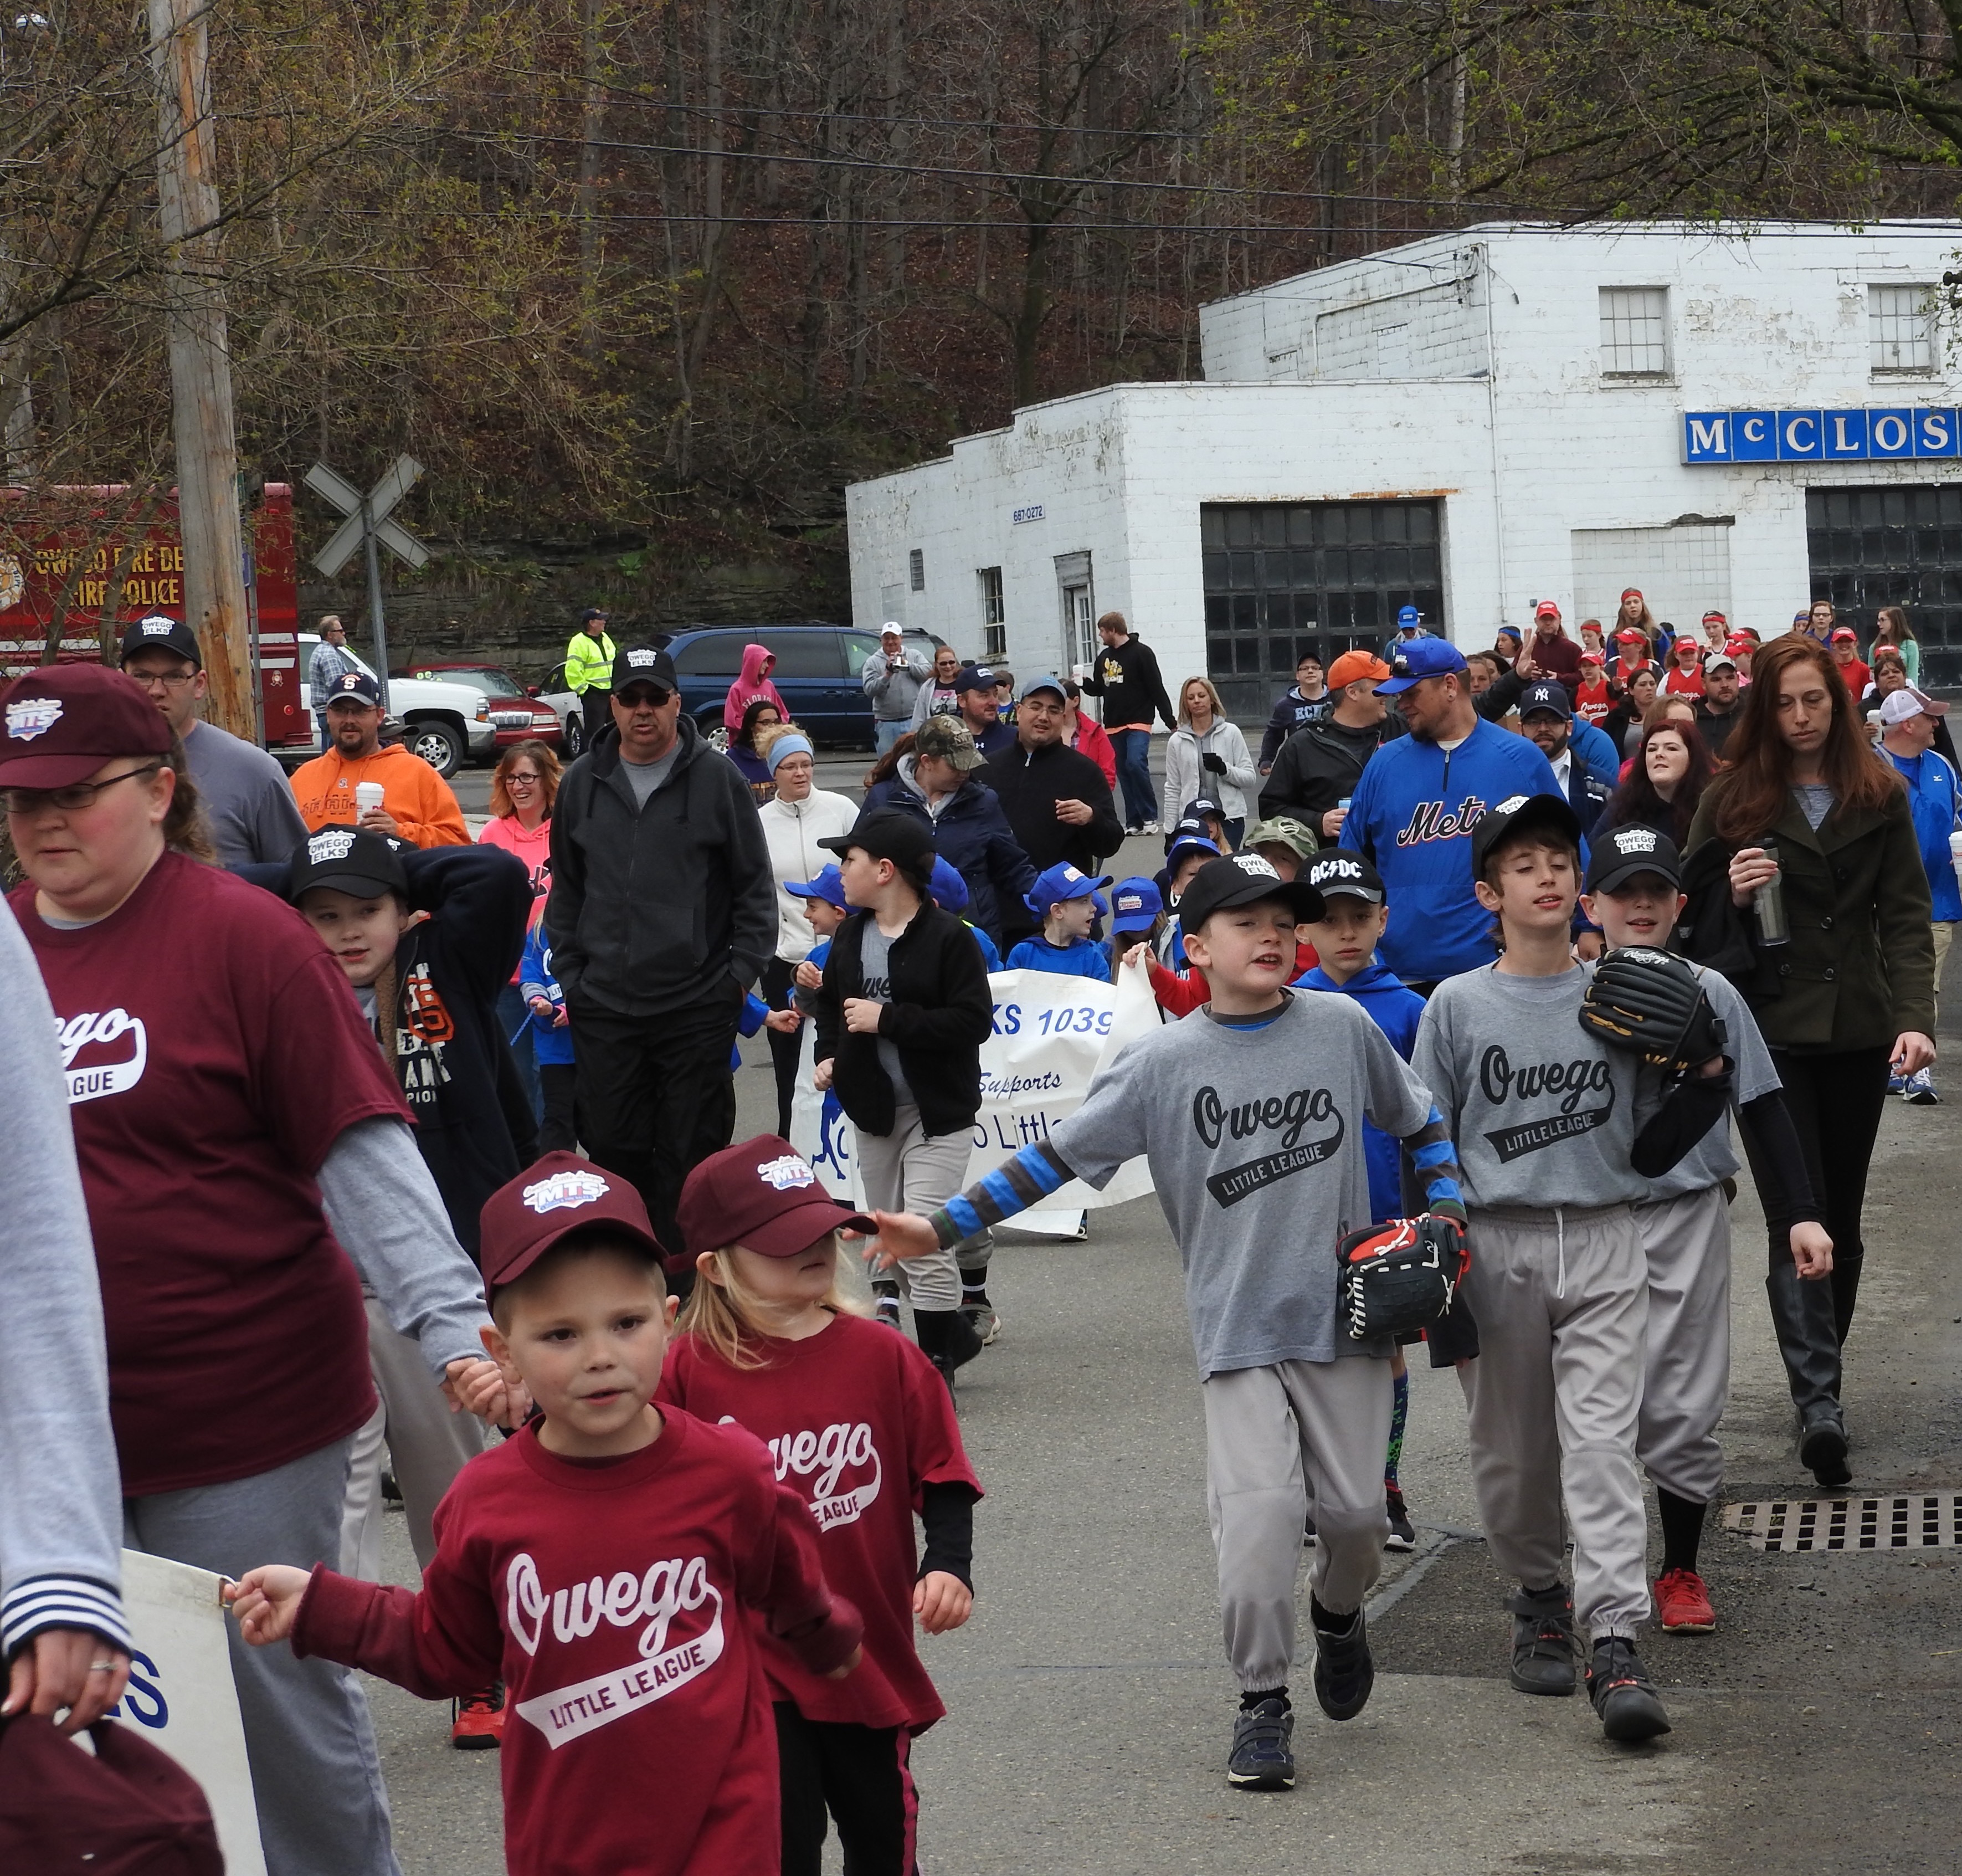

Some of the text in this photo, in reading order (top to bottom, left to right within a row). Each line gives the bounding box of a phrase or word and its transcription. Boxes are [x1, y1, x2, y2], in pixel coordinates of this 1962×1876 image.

[36, 548, 107, 575] OWO
[114, 547, 155, 572] FRE
[121, 579, 179, 605] OLICE
[1580, 702, 1607, 712] Owego
[311, 838, 350, 854] OWEGO
[1618, 836, 1654, 846] OWEGO
[1623, 843, 1652, 852] ELKS
[314, 848, 346, 862] ELKS
[1038, 1007, 1113, 1036] 1039
[979, 1071, 1062, 1099] Supports
[1480, 1044, 1610, 1114] Owego
[1193, 1086, 1332, 1150] Owego
[1504, 1126, 1549, 1152] LITTLE
[772, 1164, 813, 1184] MTS
[1221, 1144, 1324, 1196] LITTLE LEAGUE
[538, 1181, 600, 1207] MTS
[718, 1415, 872, 1500] wego
[506, 1553, 706, 1658] Owego
[549, 1643, 705, 1730] LITTLE LEAGUE
